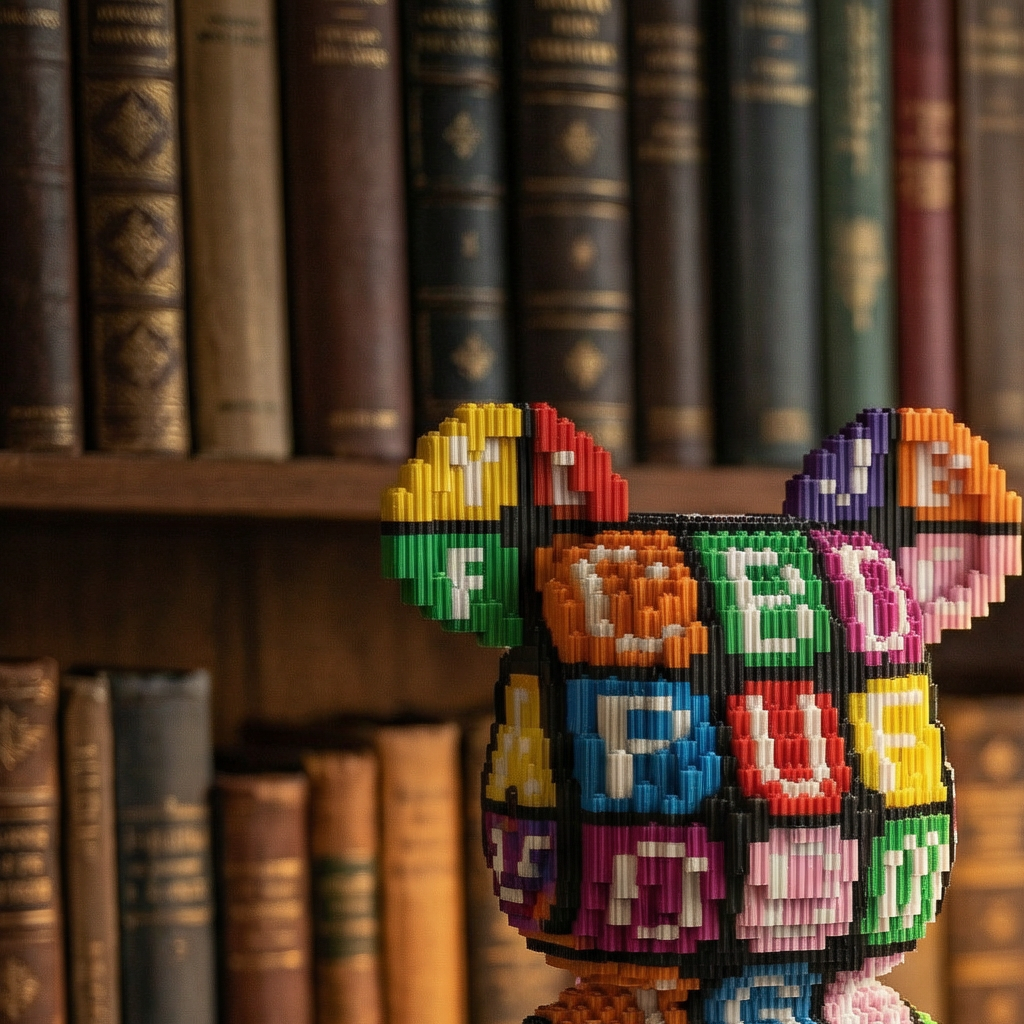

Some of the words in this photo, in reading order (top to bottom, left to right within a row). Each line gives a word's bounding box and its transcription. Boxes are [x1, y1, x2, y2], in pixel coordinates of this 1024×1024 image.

[449, 435, 500, 507] Y
[446, 547, 484, 620] F
[597, 694, 692, 800] P
[745, 693, 831, 798] U
[866, 689, 924, 793] F
